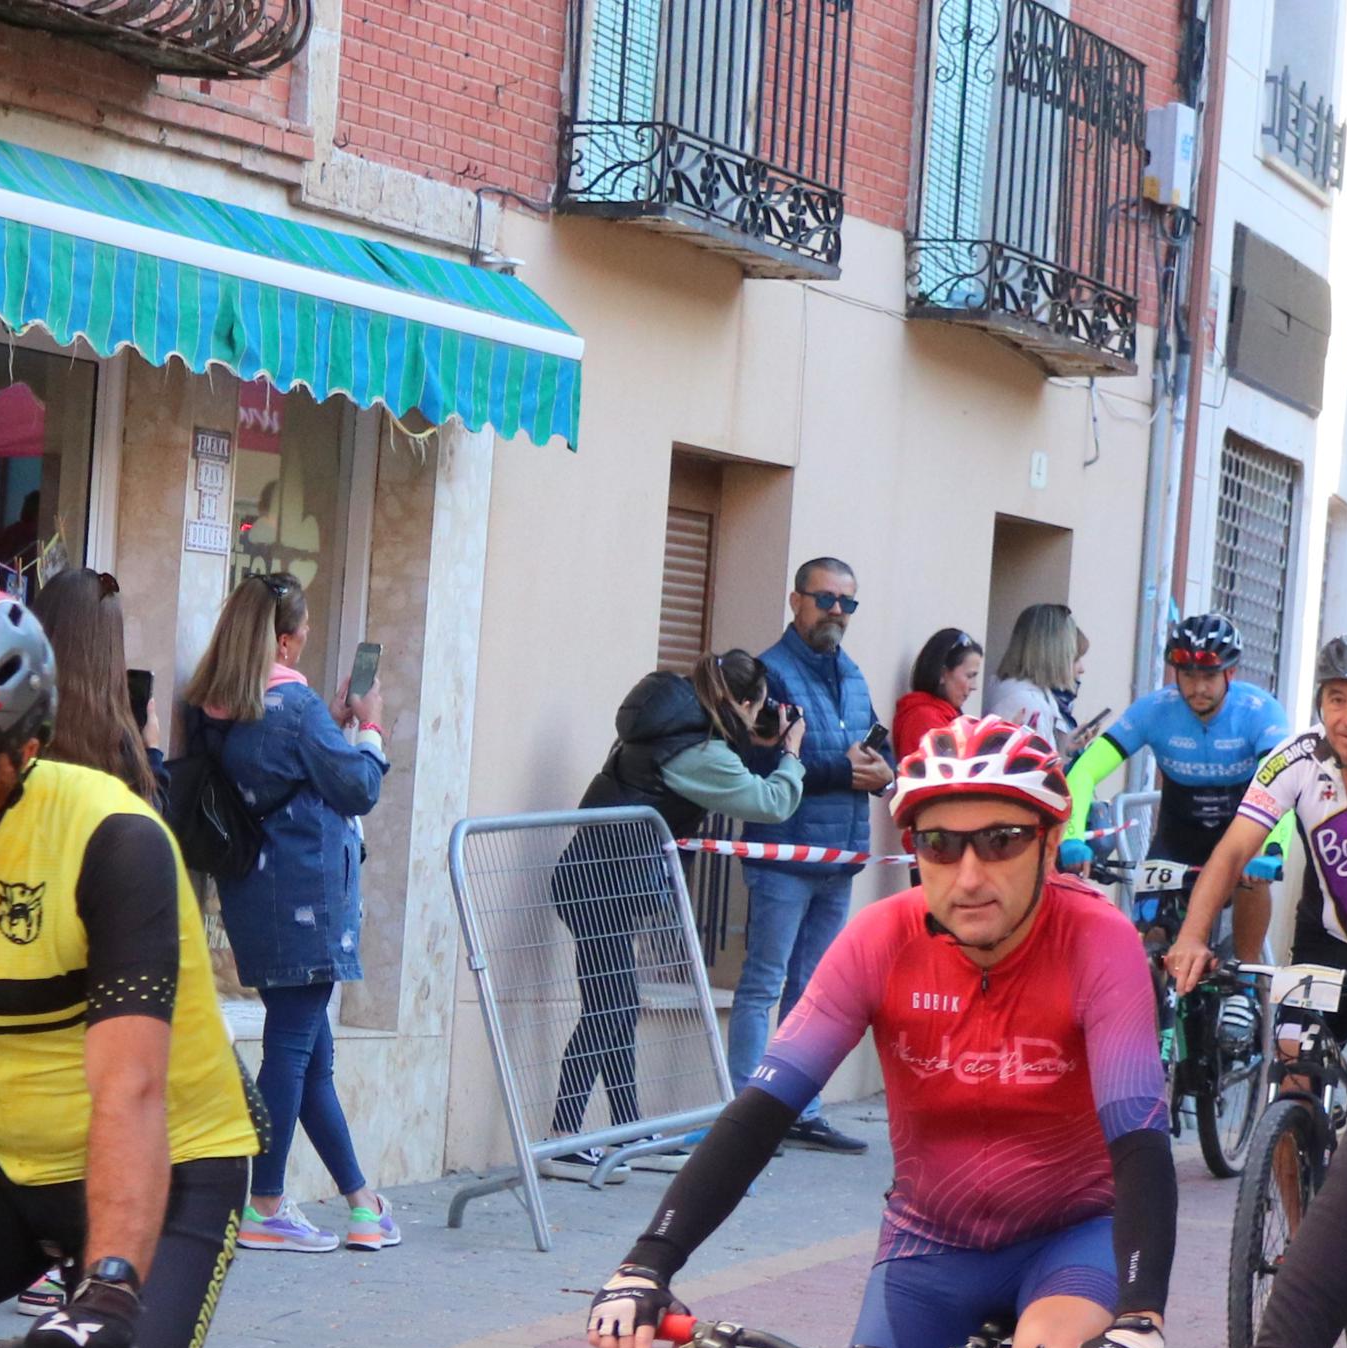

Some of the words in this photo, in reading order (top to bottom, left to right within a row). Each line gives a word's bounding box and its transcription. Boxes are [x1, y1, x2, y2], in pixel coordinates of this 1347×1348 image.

[197, 434, 229, 457] ELENA
[1145, 866, 1173, 884] 78
[1299, 975, 1314, 998] 1
[912, 992, 961, 1013] GOBIK
